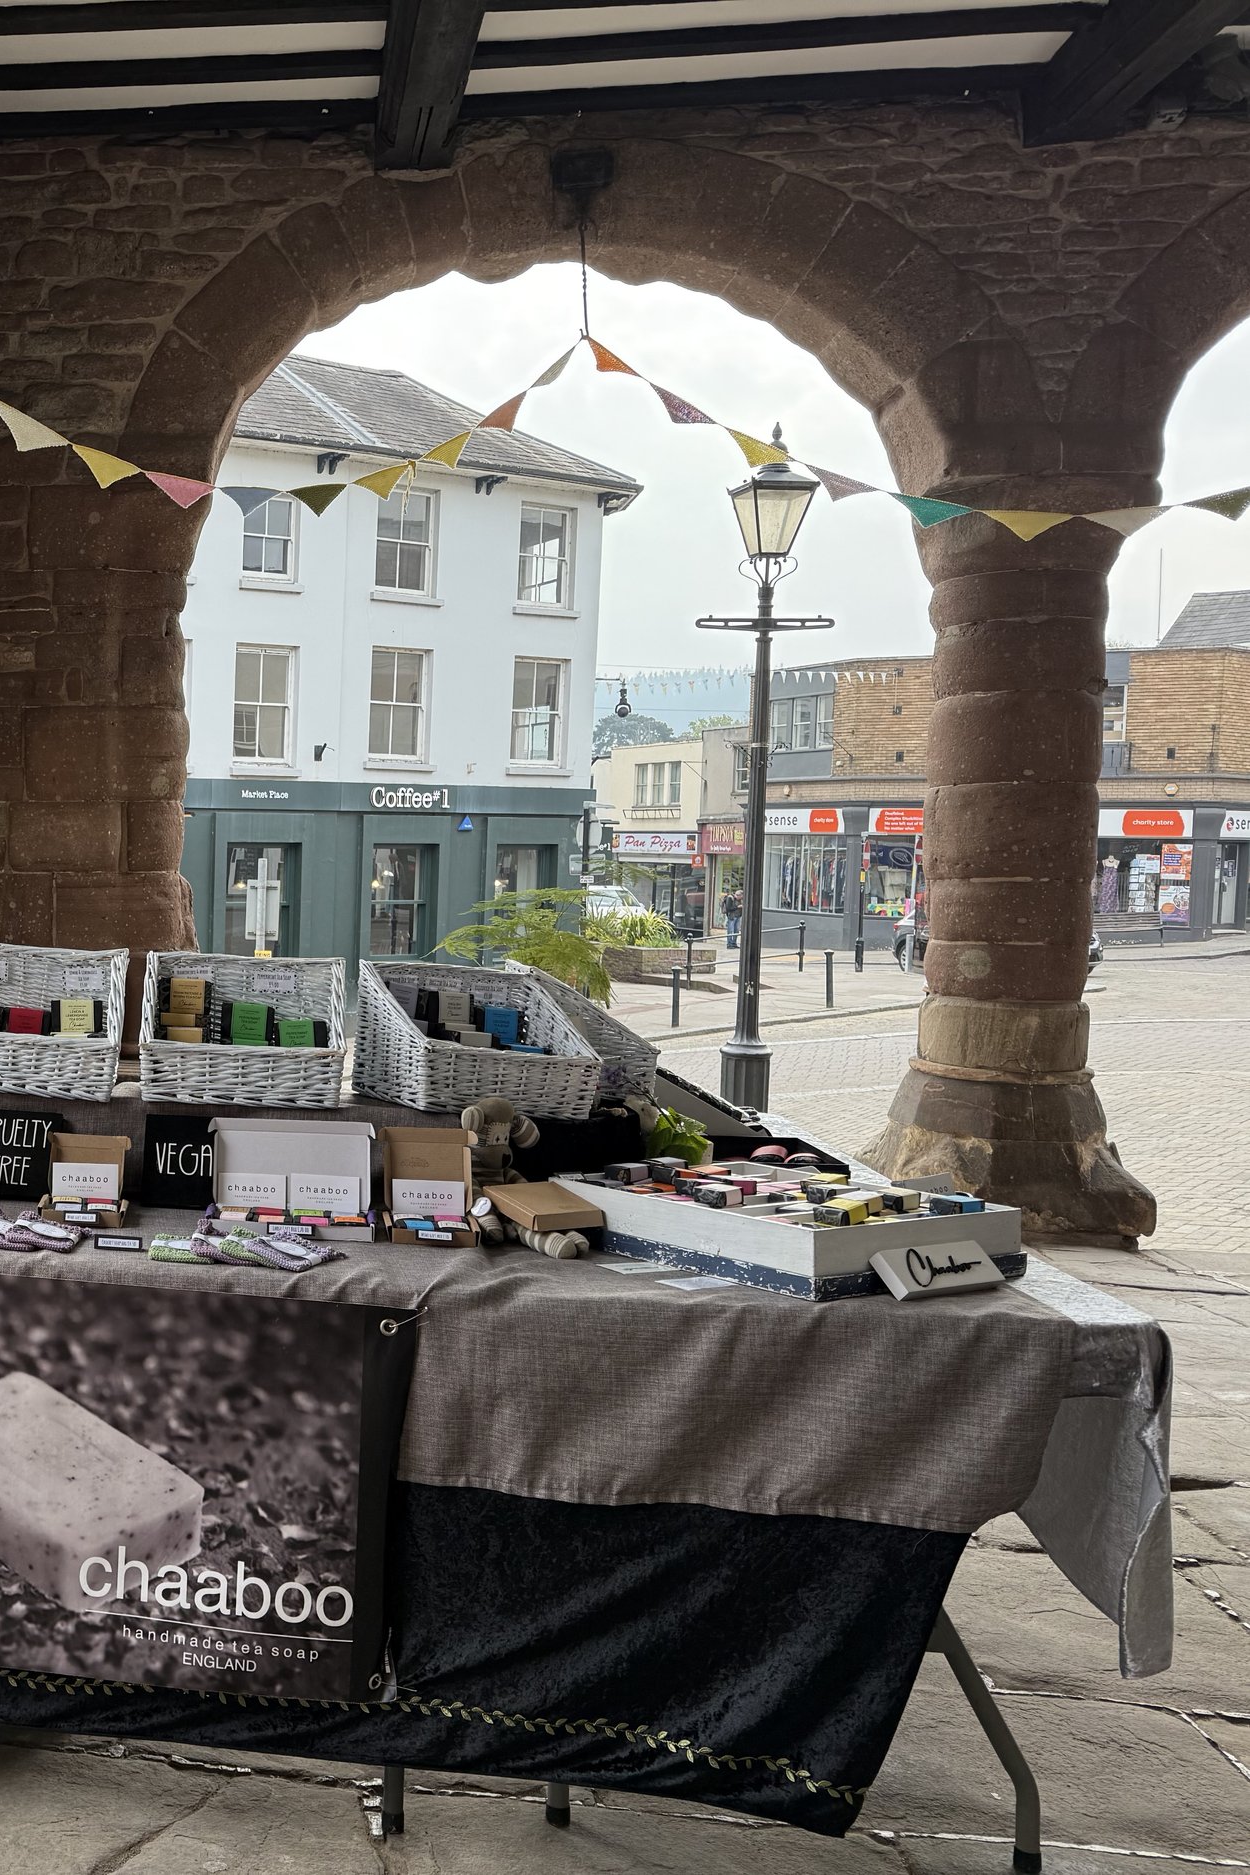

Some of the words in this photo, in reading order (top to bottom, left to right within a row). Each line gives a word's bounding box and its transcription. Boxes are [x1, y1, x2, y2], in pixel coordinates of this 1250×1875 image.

[242, 790, 268, 798] Market
[269, 790, 288, 799] Place
[370, 786, 450, 808] Coffee#1
[769, 816, 798, 825] sense
[1235, 819, 1250, 829] sen
[624, 835, 646, 848] Pan
[650, 835, 681, 852] Pizza
[156, 1142, 212, 1176] VEGA
[61, 1174, 108, 1183] chaaboo
[227, 1183, 276, 1193] chaaboo
[299, 1185, 348, 1195] chaaboo
[926, 1185, 948, 1194] aboo
[402, 1192, 453, 1200] chaaboo
[906, 1248, 982, 1287] Chaaboo
[79, 1545, 354, 1627] chaaboo
[122, 1624, 224, 1651] handmade
[232, 1640, 263, 1656] tea
[271, 1645, 319, 1663] soap
[182, 1651, 257, 1673] ENGLAND
